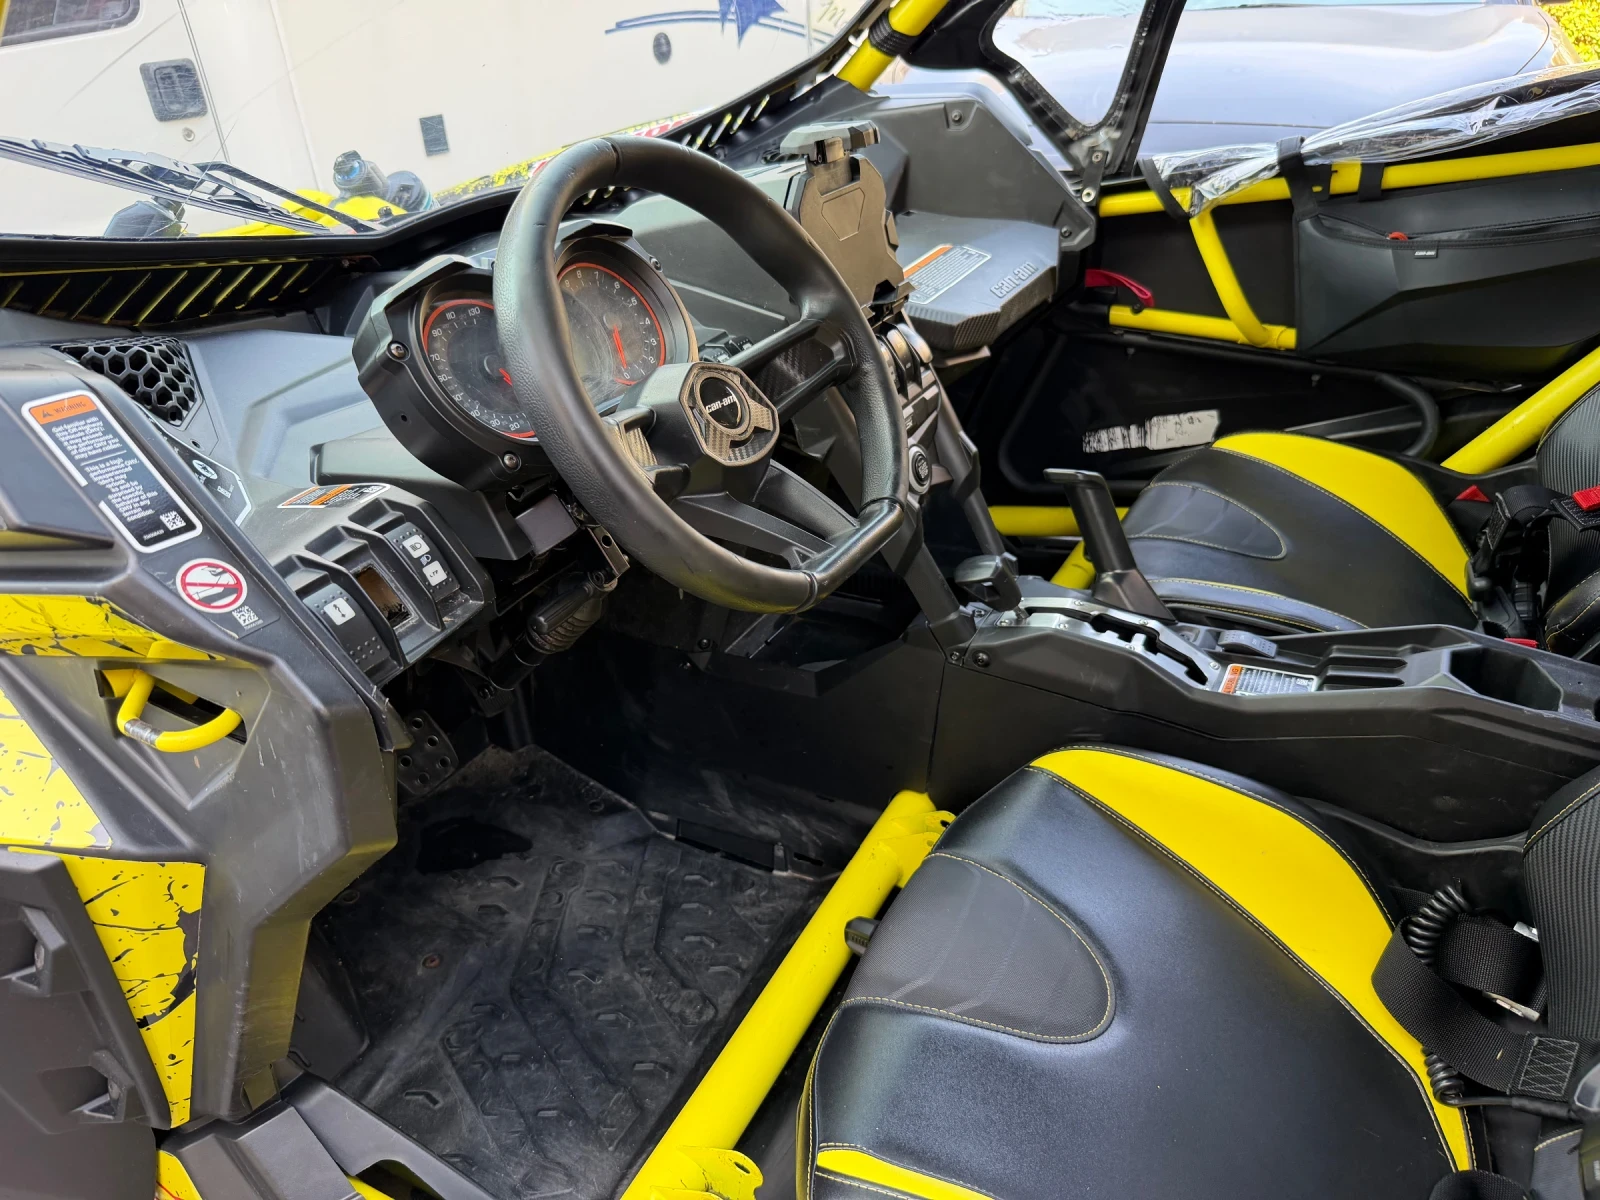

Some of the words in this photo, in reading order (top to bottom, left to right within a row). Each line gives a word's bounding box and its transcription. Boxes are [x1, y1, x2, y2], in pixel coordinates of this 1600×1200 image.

[614, 281, 621, 290] 6
[631, 297, 638, 306] 5
[645, 317, 651, 326] 4
[650, 337, 657, 346] 3
[648, 356, 656, 364] 2
[623, 371, 631, 380] 0
[53, 402, 87, 413] WARNING
[705, 394, 737, 415] can-am
